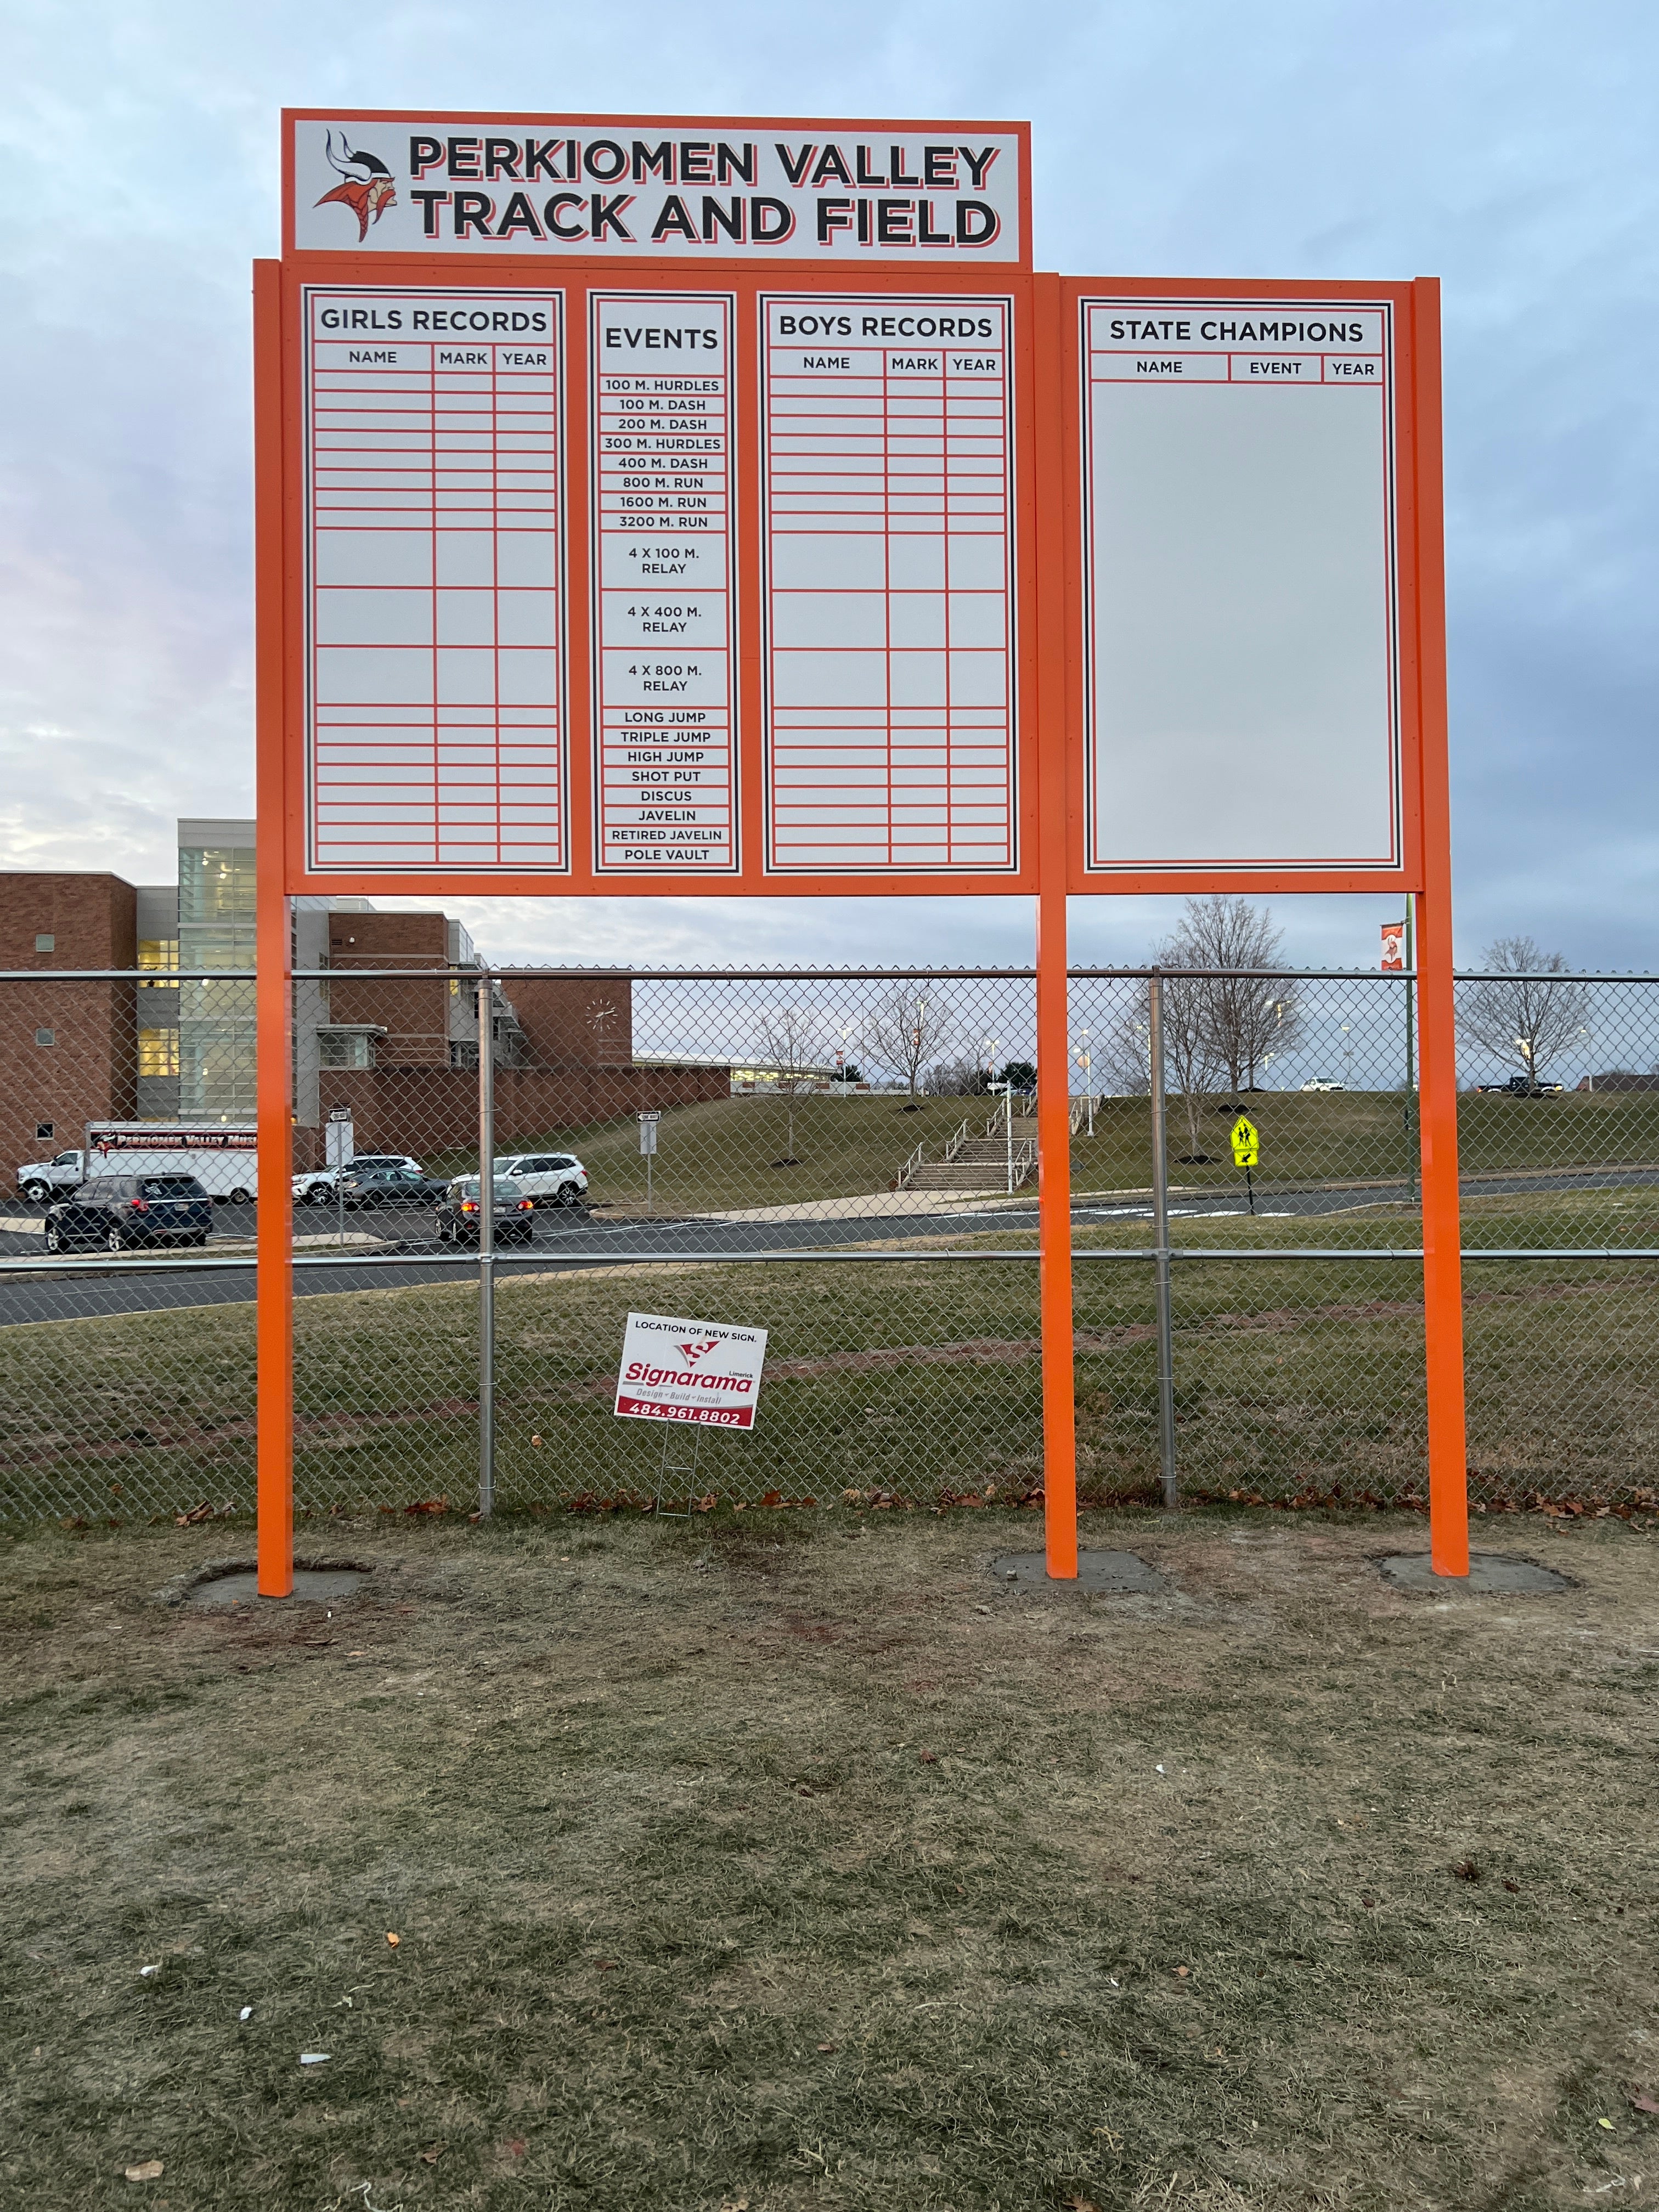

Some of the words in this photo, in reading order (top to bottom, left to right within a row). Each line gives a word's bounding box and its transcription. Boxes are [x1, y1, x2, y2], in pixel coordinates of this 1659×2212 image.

[410, 136, 758, 187] PERKIOMEN
[774, 143, 1001, 191] VALLEY
[410, 190, 637, 242] TRACK
[651, 195, 797, 245] AND
[817, 198, 1001, 248] FIELD
[321, 309, 402, 330] GIRLS
[413, 311, 546, 332] RECORDS
[780, 315, 851, 336] BOYS
[862, 317, 992, 337] RECORDS
[1110, 320, 1191, 340] STATE
[1200, 321, 1363, 342] CHAMPIONS
[606, 328, 718, 349] EVENTS
[349, 351, 397, 363] NAME
[440, 352, 487, 364] MARK
[502, 353, 546, 365] YEAR
[804, 357, 850, 369] NAME
[892, 358, 938, 370] MARK
[952, 359, 996, 371] YEAR
[1137, 361, 1182, 373] NAME
[1250, 362, 1302, 374] EVENT
[1331, 363, 1374, 375] YEAR
[606, 380, 630, 390] 100
[635, 380, 650, 390] M.
[654, 380, 719, 391] HURDLES
[619, 399, 644, 410] 100
[649, 400, 663, 410] M.
[668, 400, 706, 410] DASH
[618, 419, 645, 429] 200
[650, 419, 665, 429] M.
[669, 419, 707, 430] DASH
[605, 438, 632, 448] 300
[637, 438, 651, 449] M.
[656, 438, 720, 449] HURDLES
[618, 458, 646, 468] 400
[651, 458, 665, 468] M.
[670, 458, 708, 469] DASH
[623, 477, 650, 488] 800
[655, 477, 669, 488] M.
[674, 478, 703, 488] RUN
[620, 496, 653, 507] 1600
[658, 497, 673, 507] M.
[678, 498, 707, 507] RUN
[619, 516, 654, 527] 3200
[659, 517, 674, 527] M.
[679, 517, 708, 527] RUN
[629, 548, 637, 558] 4
[642, 548, 651, 558] X
[655, 548, 680, 558] 100
[685, 549, 699, 558] M.
[642, 563, 686, 574] RELAY
[628, 606, 636, 617] 4
[641, 606, 650, 617] X
[654, 607, 682, 617] 400
[687, 607, 701, 617] M.
[643, 622, 687, 633] RELAY
[629, 665, 637, 675] 4
[642, 665, 651, 675] X
[656, 665, 682, 676] 800
[687, 665, 702, 676] M.
[644, 681, 688, 691] RELAY
[625, 712, 664, 723] LONG
[668, 712, 706, 723] JUMP
[620, 732, 669, 742] TRIPLE
[673, 732, 711, 742] JUMP
[628, 752, 662, 762] HIGH
[667, 752, 704, 762] JUMP
[632, 771, 669, 782] SHOT
[674, 771, 701, 782] PUT
[641, 791, 692, 802] DISCUS
[639, 810, 696, 821] JAVELIN
[612, 831, 666, 840] RETIRED
[670, 831, 721, 840] JAVELIN
[625, 850, 661, 860] POLE
[665, 850, 709, 860] VAULT
[228, 1135, 257, 1146] MUSI
[635, 1321, 686, 1334] LOCATION
[705, 1329, 729, 1339] NEW
[625, 1362, 753, 1392] Signarama
[636, 1388, 663, 1398] Design
[670, 1392, 690, 1401] Build
[697, 1395, 721, 1404] Install
[629, 1403, 740, 1424] 484.961.8802
